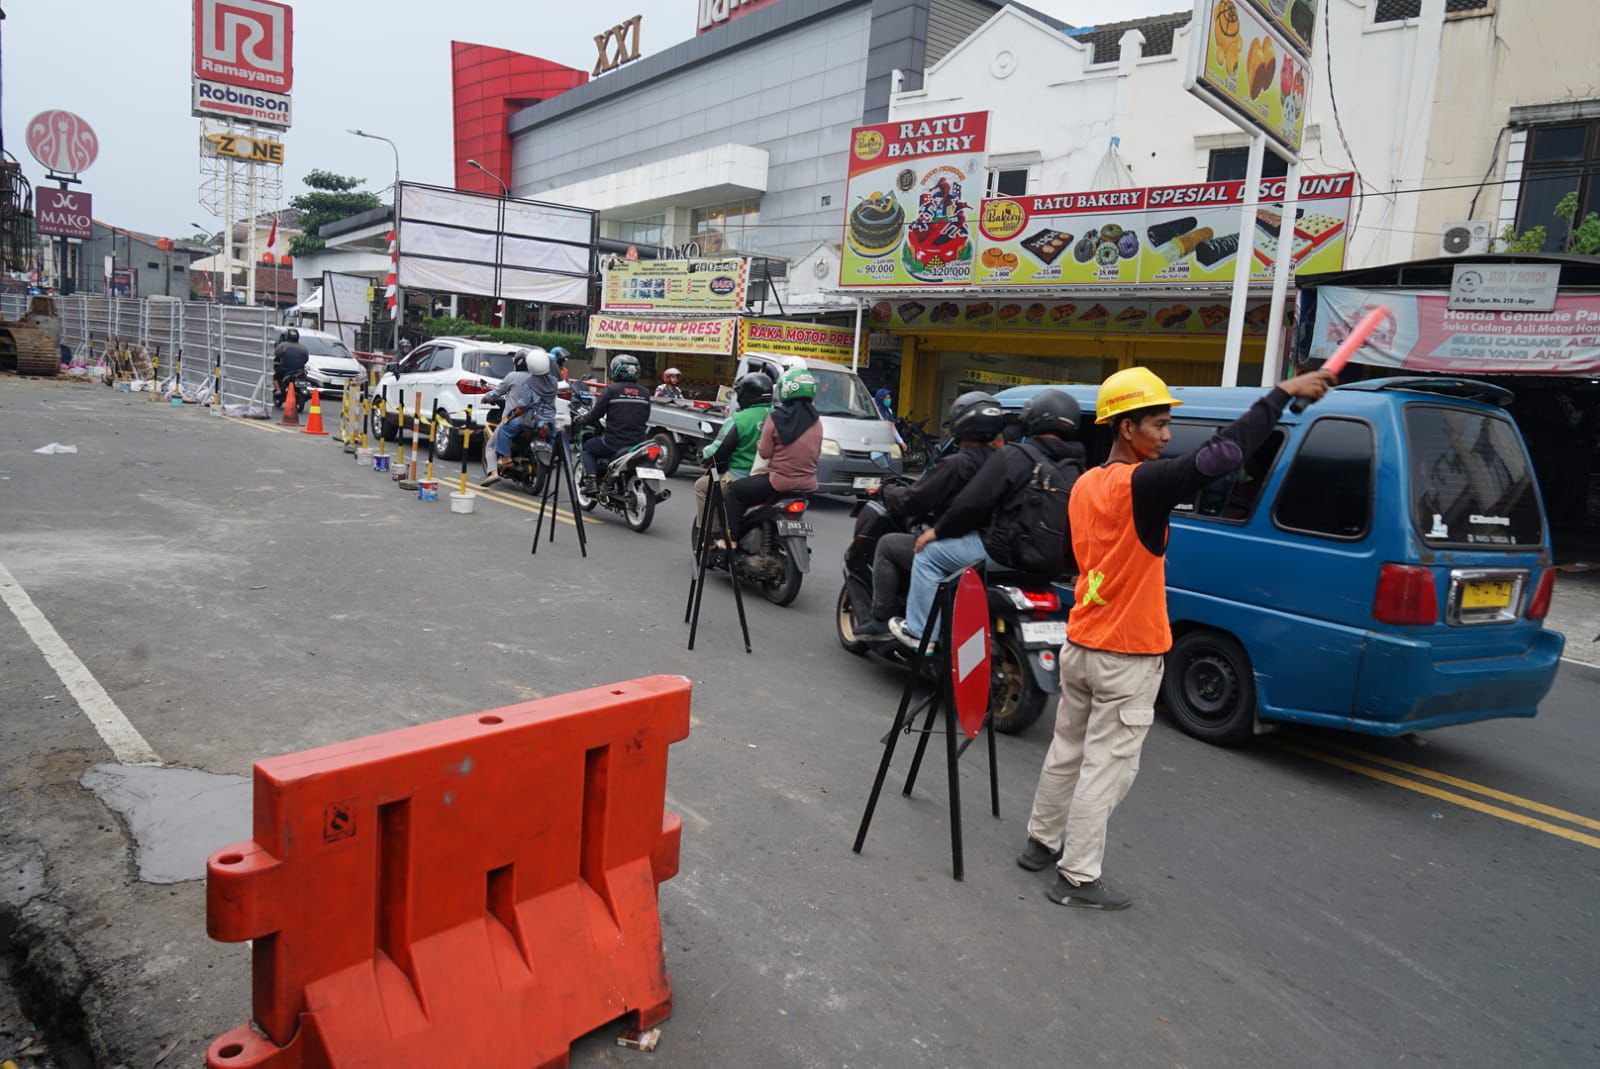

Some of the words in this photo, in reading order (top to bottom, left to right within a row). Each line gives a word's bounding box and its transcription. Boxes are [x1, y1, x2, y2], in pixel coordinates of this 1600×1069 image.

[592, 14, 643, 77] XXI
[202, 59, 285, 85] Ramayana
[199, 83, 288, 113] Robinson
[255, 109, 288, 123] mart
[899, 117, 966, 139] RATU
[887, 135, 976, 157] BAKERY
[1150, 186, 1228, 205] SPESIAL
[1236, 176, 1351, 201] DSCUNT
[1033, 196, 1075, 211] RATU
[1077, 192, 1142, 208] BAKERY
[41, 210, 90, 230] MAKO
[865, 264, 895, 273] 90.000
[932, 267, 970, 276] 120.000
[1443, 309, 1495, 321] Honda
[1500, 311, 1571, 322] Genuine
[1575, 310, 1600, 321] Pa
[598, 319, 629, 331] RAKA
[633, 321, 677, 333] MOTOR
[680, 321, 722, 335] PRESS
[748, 323, 783, 340] RAKA
[786, 328, 827, 345] MOTOR
[829, 333, 856, 347] PRES
[1442, 322, 1469, 331] Suku
[1471, 322, 1512, 333] Cadang
[1515, 323, 1537, 333] Asli
[1539, 324, 1574, 333] Motor
[1452, 335, 1493, 345] SUKU
[1496, 337, 1562, 347] CADANG
[1566, 336, 1600, 347] ASL
[1450, 348, 1485, 357] DARI
[1488, 349, 1528, 359] YANG
[1533, 350, 1573, 360] AHLI
